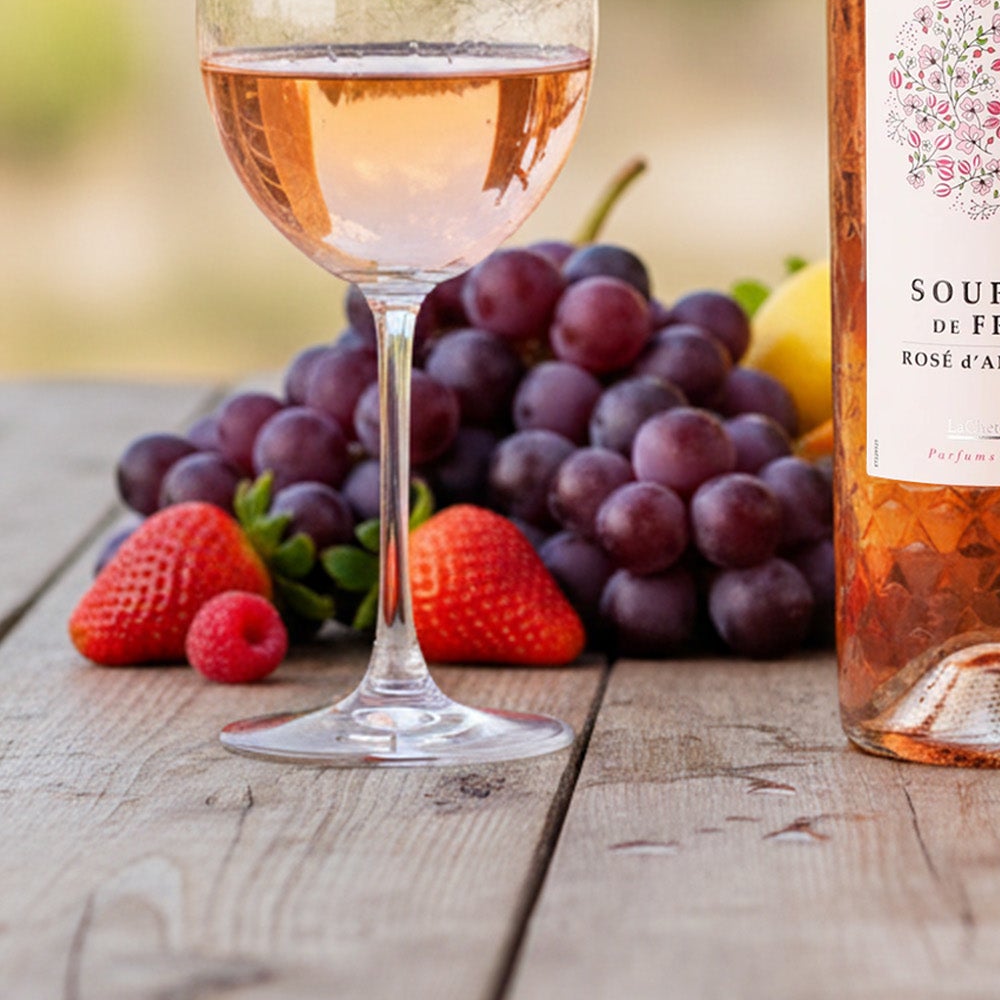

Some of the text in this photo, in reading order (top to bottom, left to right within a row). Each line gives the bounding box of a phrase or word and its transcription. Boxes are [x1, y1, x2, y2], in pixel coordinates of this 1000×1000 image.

[932, 318, 961, 335] DE
[901, 350, 954, 369] ROSÉ
[927, 448, 996, 464] Parfums
